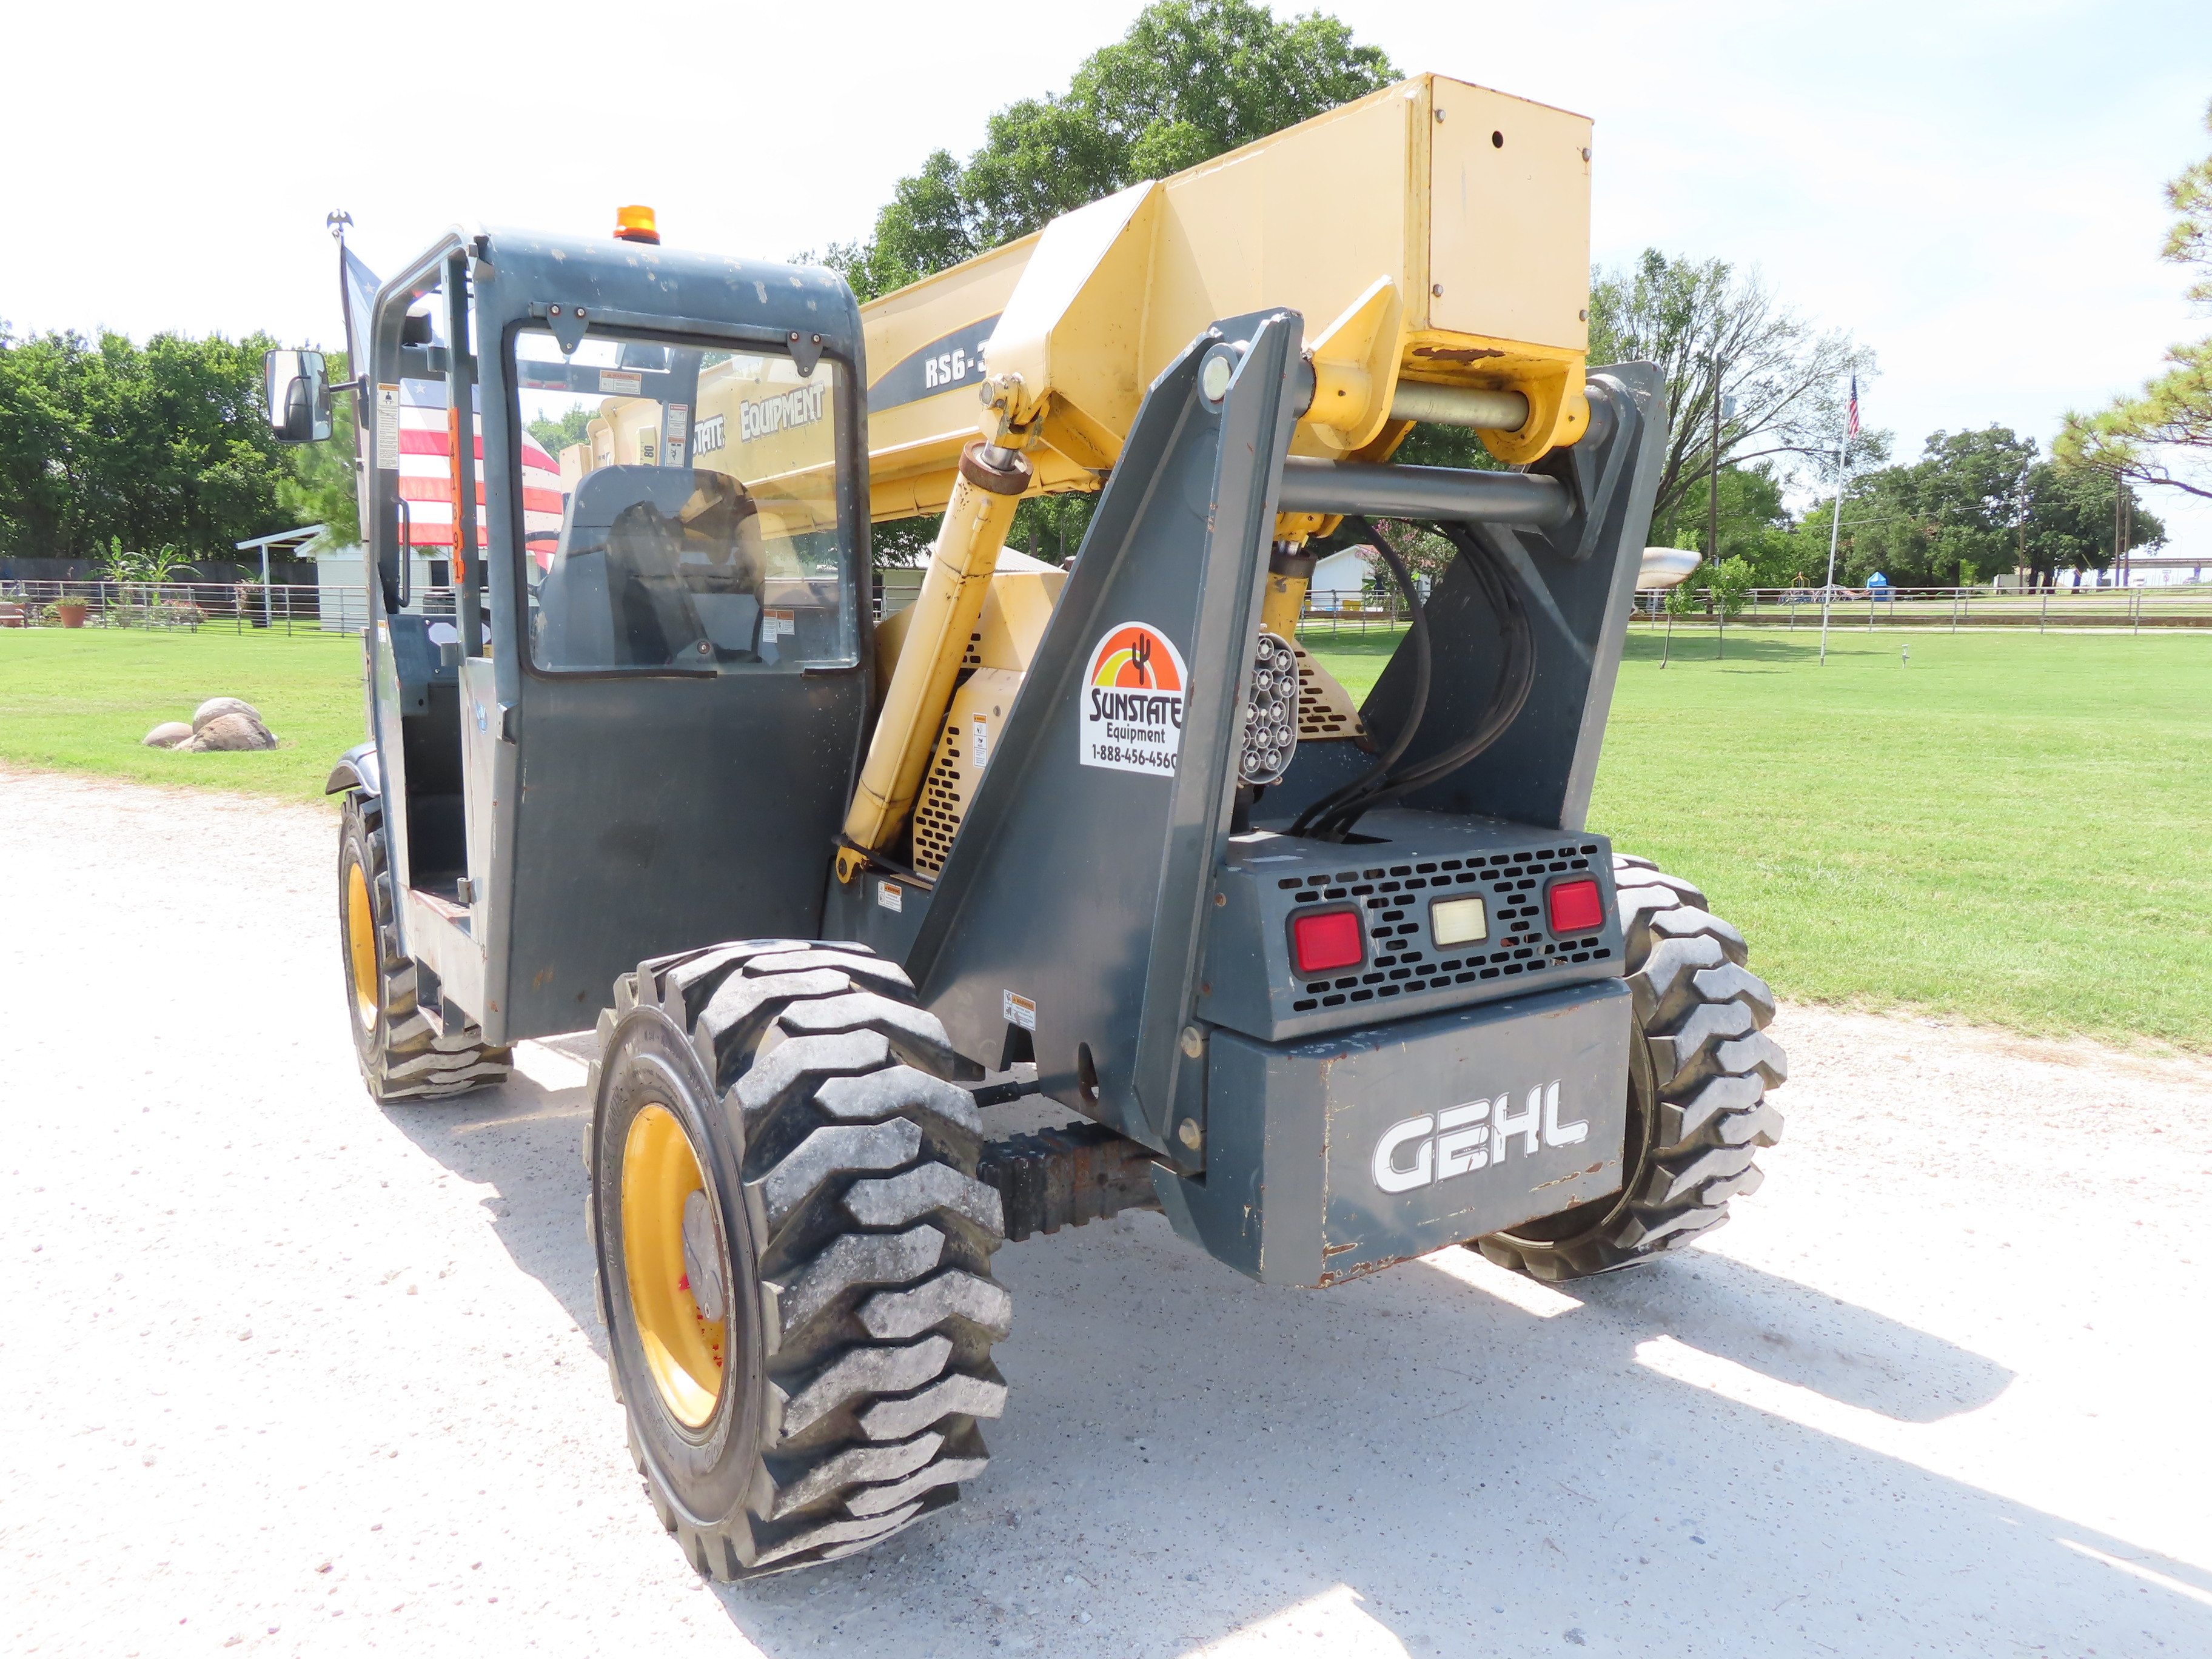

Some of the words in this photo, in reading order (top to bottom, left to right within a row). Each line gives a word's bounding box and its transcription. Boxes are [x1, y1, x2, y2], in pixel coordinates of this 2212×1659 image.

[740, 381, 825, 443] EQUIPMENT
[644, 445, 654, 458] 80
[1089, 688, 1182, 729] SUNSTATE
[1107, 722, 1165, 744] Equipment
[1372, 1079, 1590, 1195] GEHL
